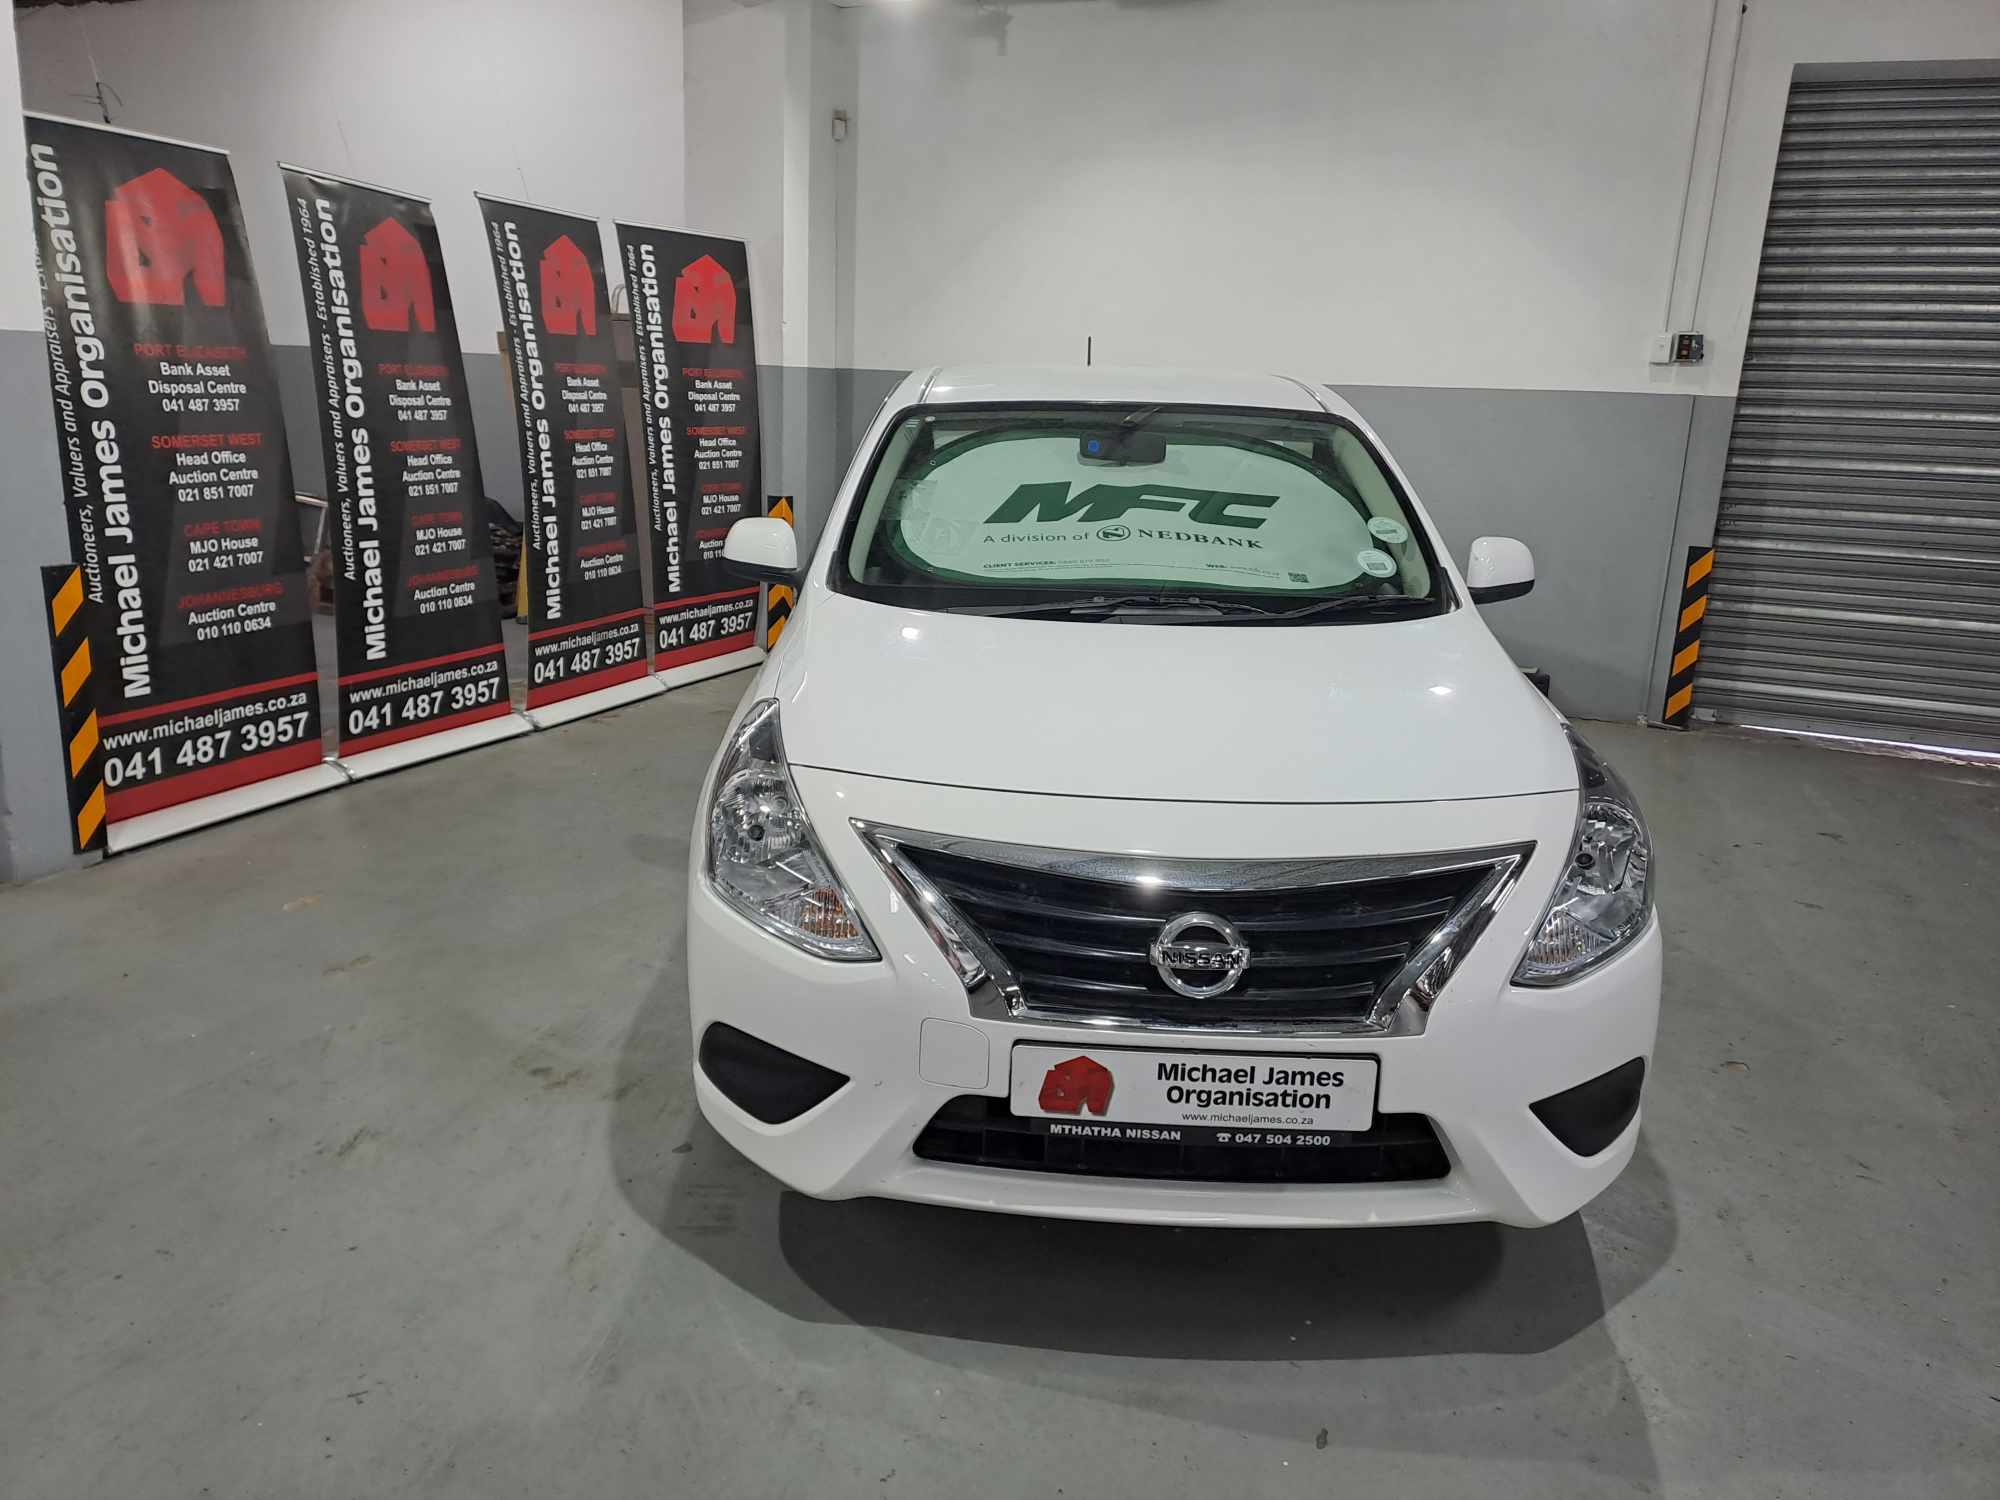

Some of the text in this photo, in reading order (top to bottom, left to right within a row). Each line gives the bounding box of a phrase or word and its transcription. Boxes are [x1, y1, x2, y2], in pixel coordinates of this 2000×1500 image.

[297, 197, 313, 235] 1964
[30, 144, 109, 408] Organisation
[304, 237, 328, 321] Established
[160, 362, 231, 377] Bank Asset
[321, 332, 341, 409] Appraisers
[148, 380, 246, 396] Disposal Centre
[418, 380, 441, 391] Asset
[162, 399, 239, 412] 041 487 3957
[389, 395, 424, 407] Disposal
[316, 198, 387, 661] Michael James Organisation
[329, 410, 343, 438] and
[504, 221, 562, 620] Michael James Organisation
[640, 244, 680, 592] Michael James Organisation
[151, 434, 225, 449] SOMERSET
[43, 306, 104, 603] Auctioneers, Valuers and Appraisers
[176, 451, 246, 466] Head Office
[407, 454, 452, 466] Head Office
[169, 469, 258, 485] Auction Centre
[335, 442, 349, 493] Valuers
[402, 468, 461, 482] Auction Centre
[92, 419, 133, 543] James
[178, 484, 254, 502] 021 851 7007
[984, 480, 1281, 529] MFC
[189, 537, 258, 554] MJO House
[437, 527, 463, 539] House
[983, 528, 1263, 550] A division of NEDBANK
[188, 551, 264, 572] 021 421 7007
[414, 581, 475, 601] Auction Centre
[107, 553, 151, 698] Michael
[188, 601, 276, 625] Auction Centre
[197, 616, 272, 641] 010 110 0634
[535, 622, 639, 657] www.michaeljames.co.za
[659, 612, 752, 649] 041 487 3957
[534, 637, 641, 684] 041 487 3957
[349, 660, 498, 704] www.michaeljames.co.za
[349, 677, 500, 735] 041 487 3957
[103, 690, 307, 752] www.michaeljames.co.za
[104, 712, 310, 788] 041 487 3957
[1161, 950, 1241, 968] NISSAN
[1157, 1062, 1344, 1088] Michael James
[1166, 1085, 1331, 1110] Organisation
[1181, 1111, 1314, 1127] www.michaeljames.co.za
[1049, 1123, 1331, 1147] MTHATHA NISSAN 047 504 2500
